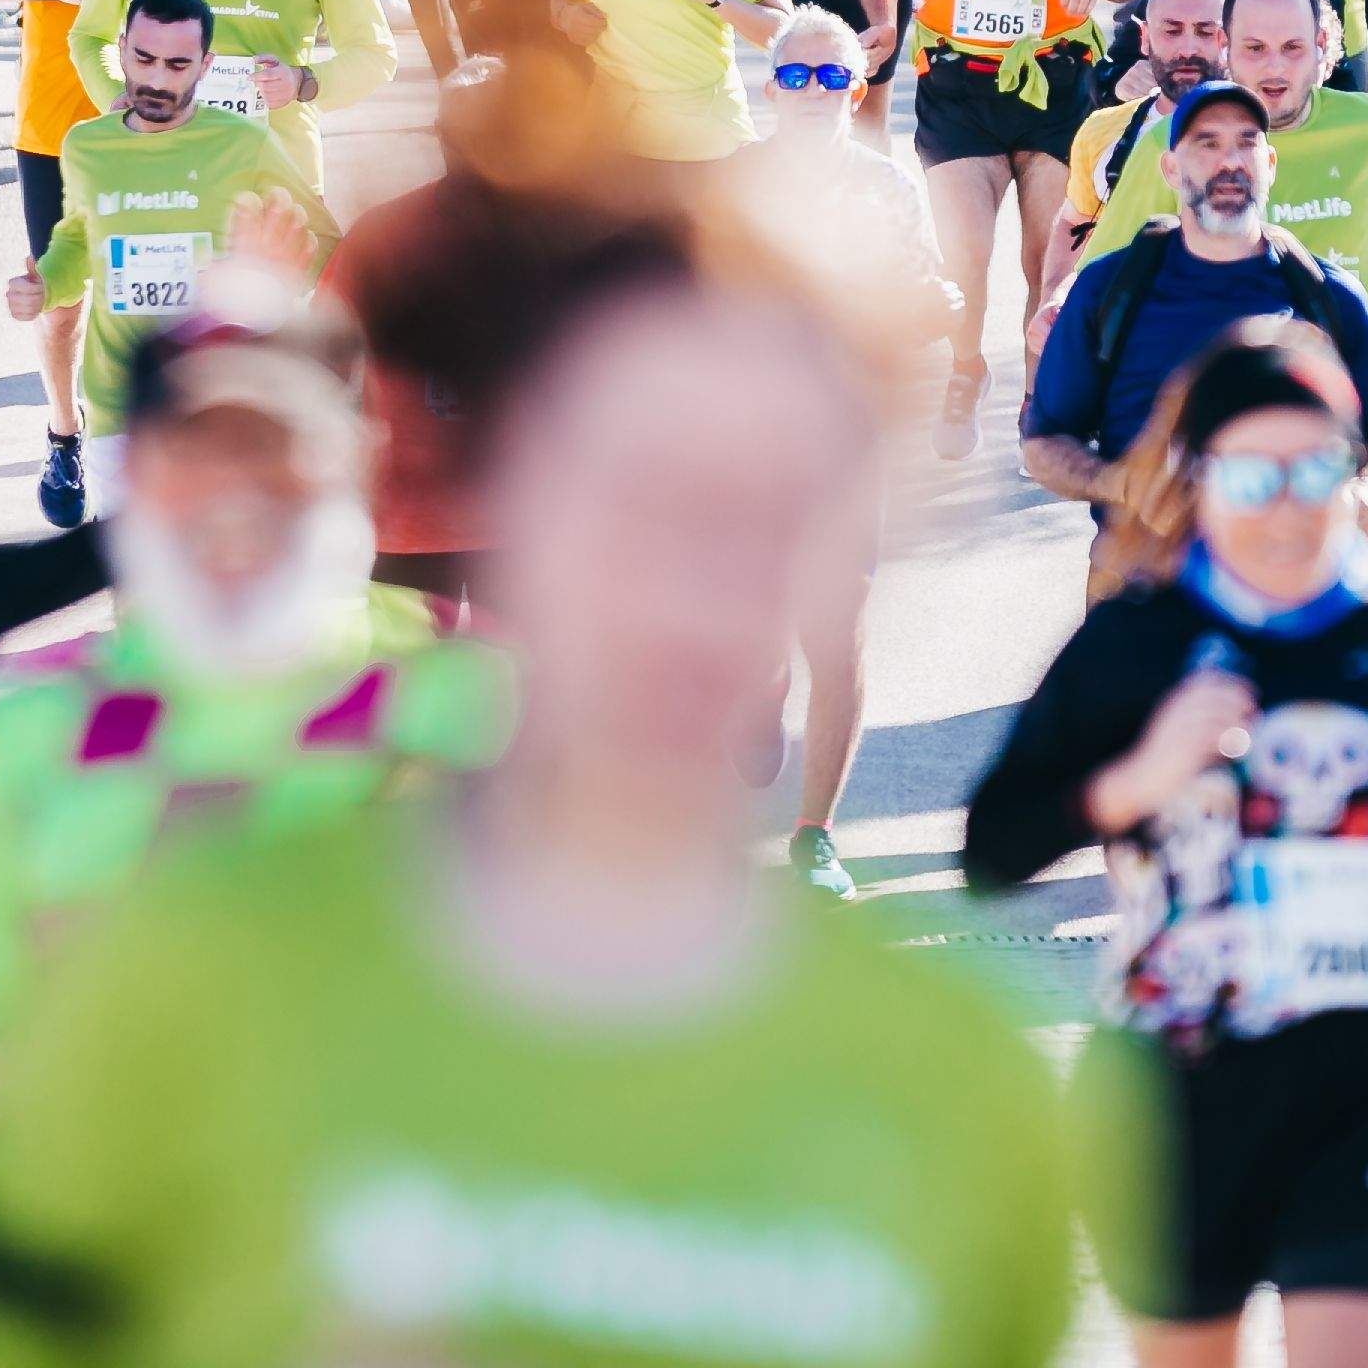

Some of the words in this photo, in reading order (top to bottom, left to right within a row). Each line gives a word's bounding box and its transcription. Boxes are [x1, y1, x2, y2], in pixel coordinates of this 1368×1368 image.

[974, 11, 1024, 34] 2565
[212, 66, 250, 75] MetLife
[124, 190, 199, 210] MetLife
[1272, 197, 1352, 223] MetLife
[145, 245, 187, 254] MetLife
[132, 282, 190, 307] 3822
